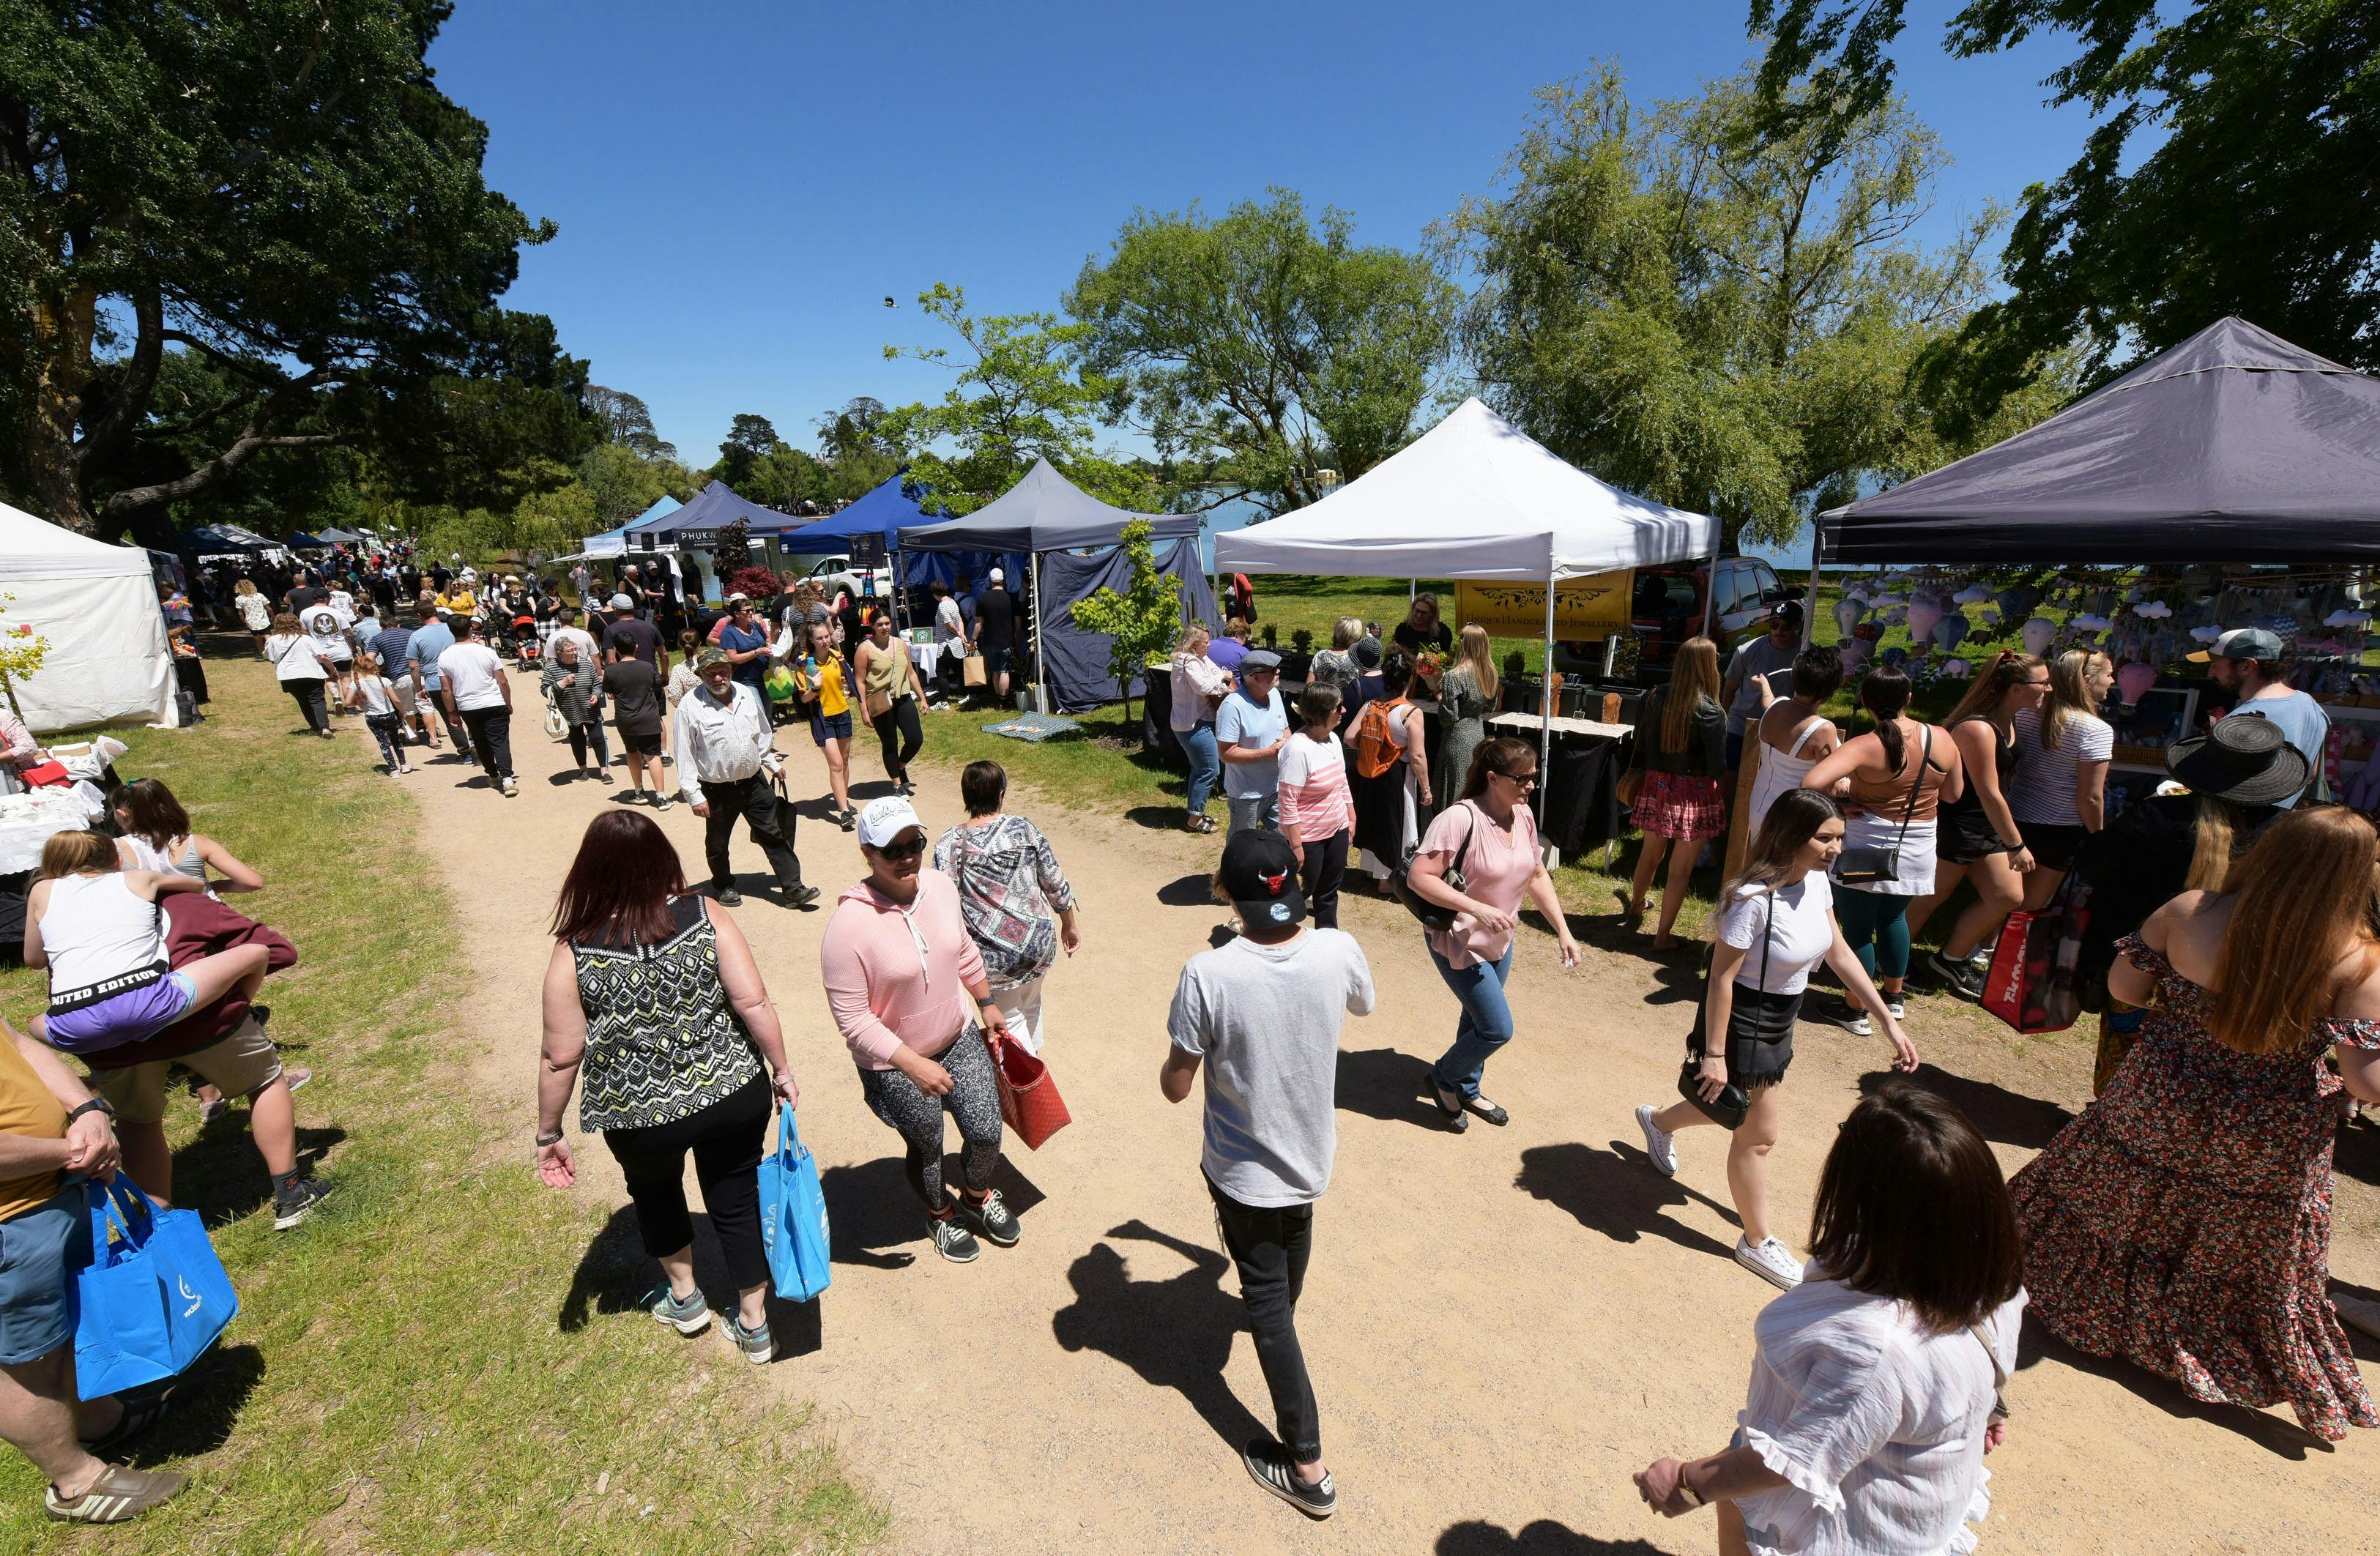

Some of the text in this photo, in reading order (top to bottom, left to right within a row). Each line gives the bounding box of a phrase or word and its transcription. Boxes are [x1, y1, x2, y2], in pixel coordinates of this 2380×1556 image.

[1502, 615, 1567, 627] HANDCRATED
[1570, 617, 1617, 628] JEWELLERY
[97, 969, 160, 994] EDITION
